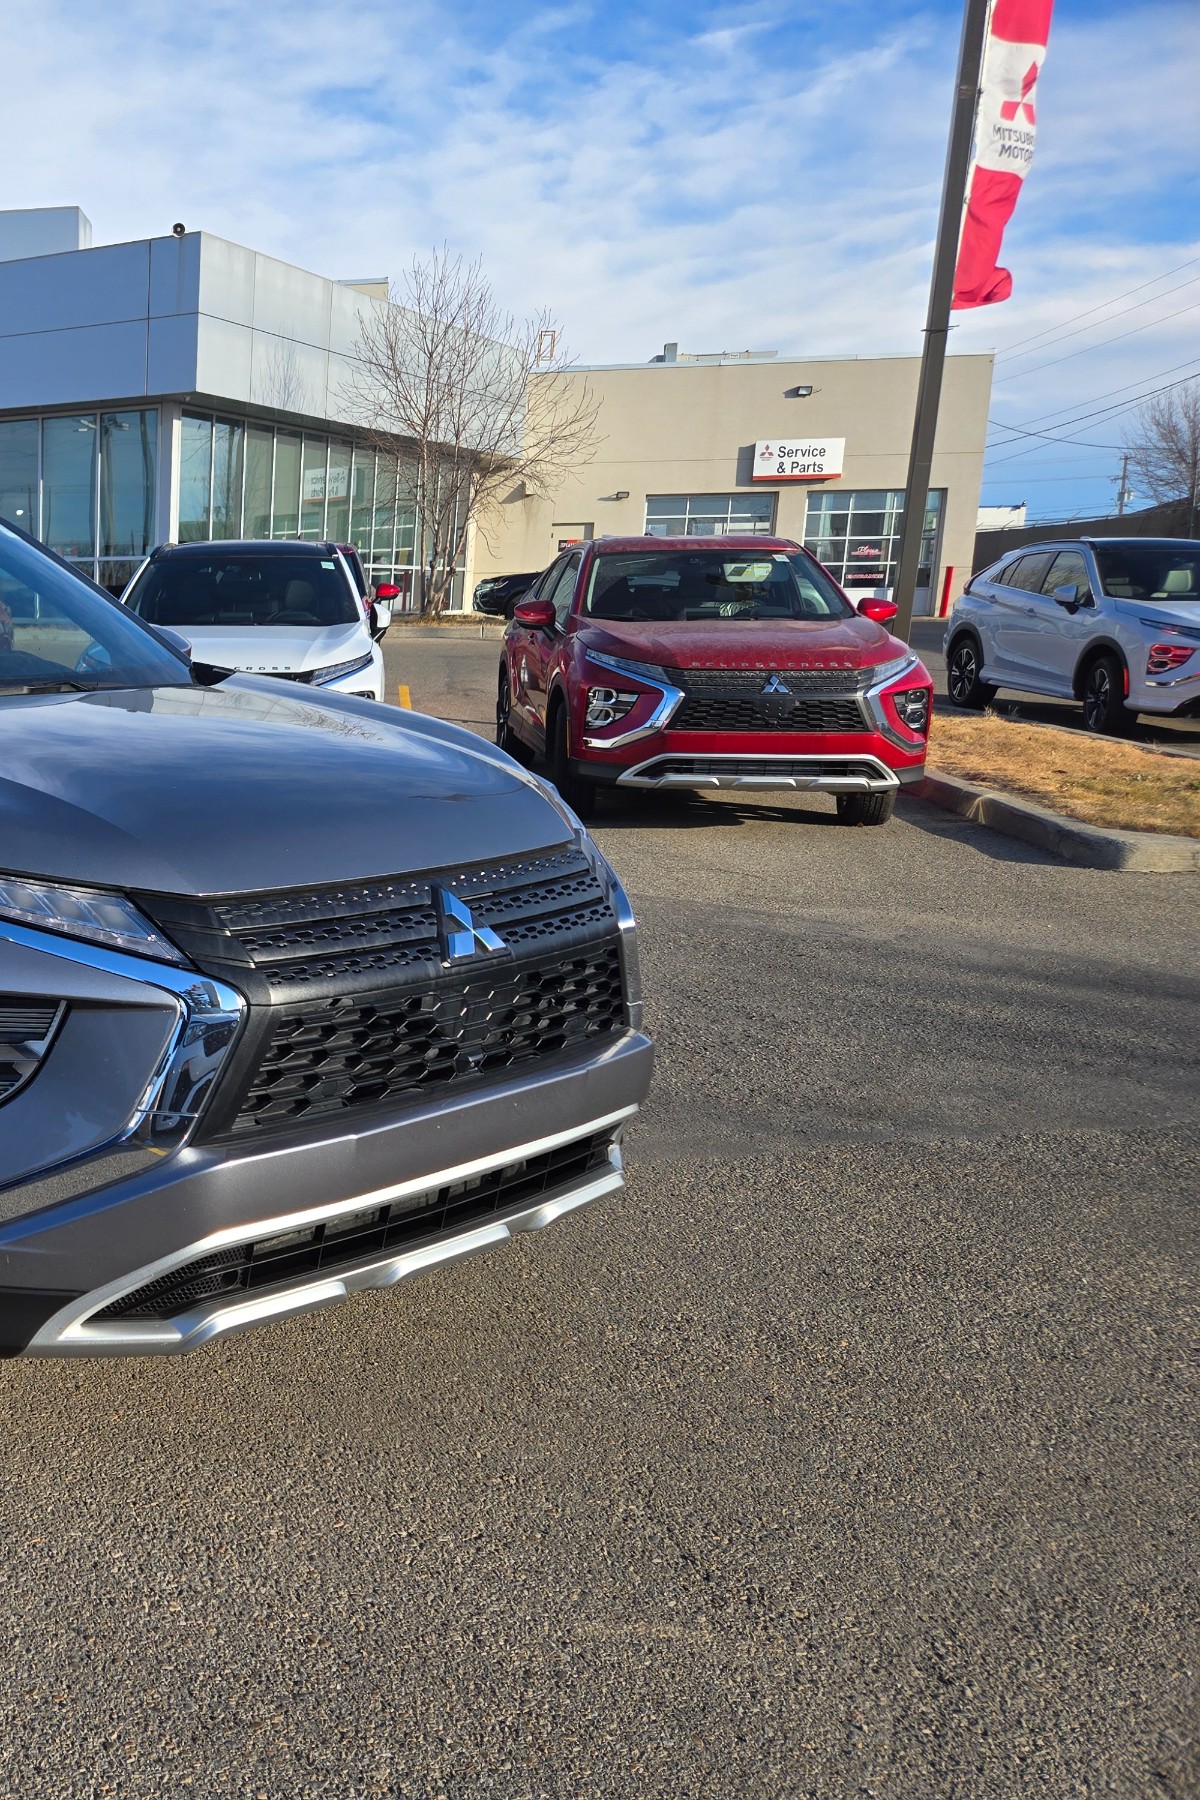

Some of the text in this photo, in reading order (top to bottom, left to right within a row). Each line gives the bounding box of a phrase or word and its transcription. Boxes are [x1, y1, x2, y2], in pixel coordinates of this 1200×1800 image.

[777, 445, 826, 459] Service
[776, 461, 824, 474] & Parts
